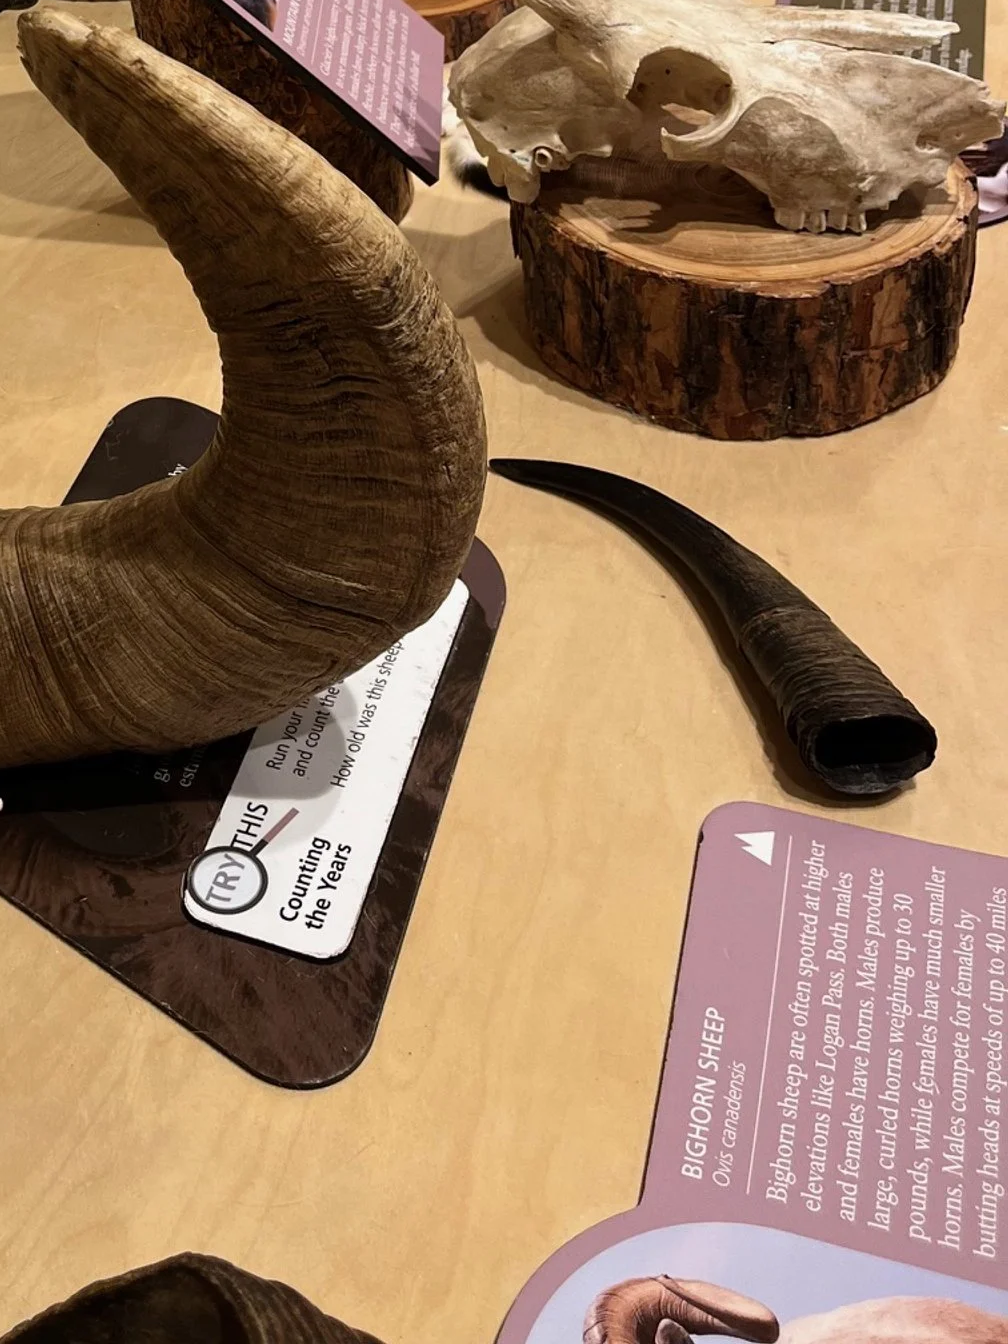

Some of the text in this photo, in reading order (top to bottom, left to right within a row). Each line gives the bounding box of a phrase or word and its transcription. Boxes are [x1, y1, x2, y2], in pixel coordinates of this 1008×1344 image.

[283, 0, 299, 45] MOUNTAIN
[292, 686, 340, 777] and count the
[356, 703, 378, 728] was
[366, 677, 387, 700] this
[265, 710, 303, 771] Run your
[327, 752, 356, 788] How
[341, 729, 366, 753] old
[204, 801, 269, 903] TRY THIS
[279, 836, 332, 922] Counting
[304, 843, 352, 930] the Years
[765, 839, 830, 1204] Bighorn sheep are often spotted at higher
[800, 871, 854, 1212] elevations like Logan Pass. Both males
[835, 867, 886, 1222] and females have horns. Males produce
[867, 893, 917, 1232] large, curled horns weighing up to 30
[906, 865, 946, 1243] pounds, while females have much smaller
[681, 1006, 725, 1180] BIGHORN SHEEP
[712, 1060, 747, 1187] Ovis canadensis
[937, 908, 982, 1251] horns. Males compete for females by
[972, 887, 1008, 1259] butting heads at speeds of up to 40 miles
